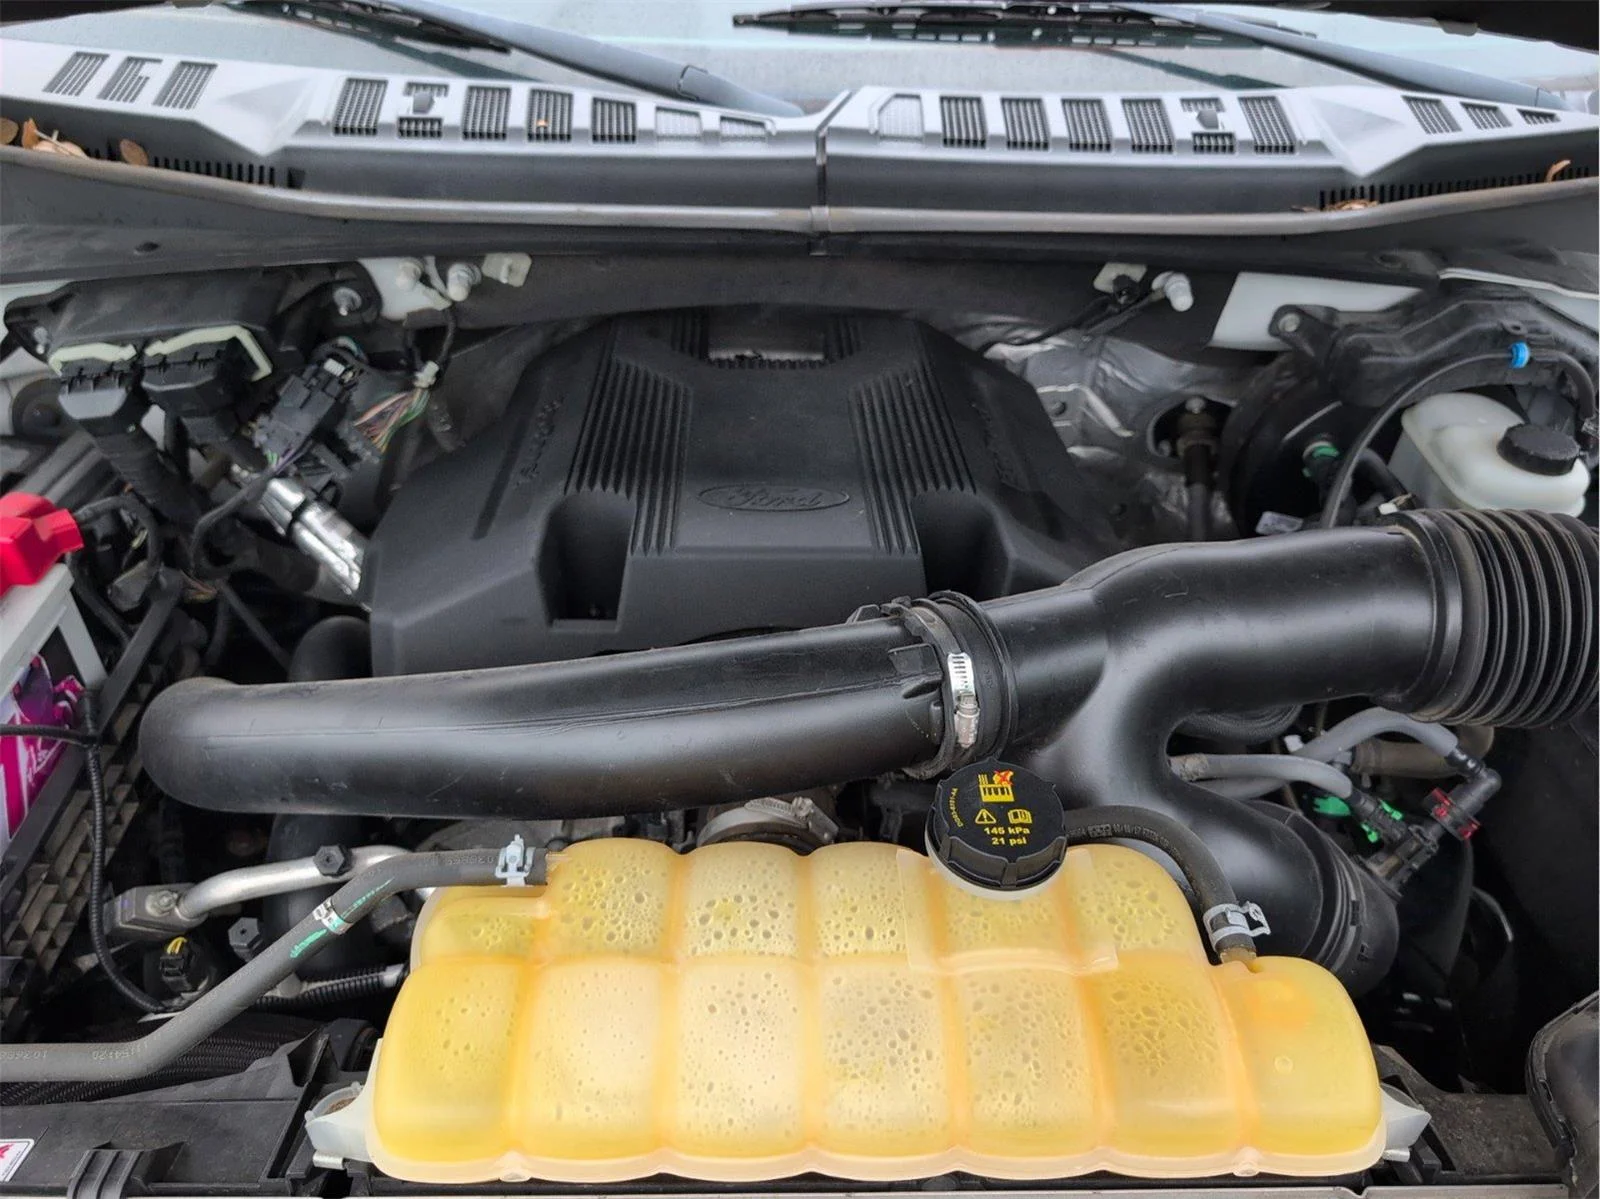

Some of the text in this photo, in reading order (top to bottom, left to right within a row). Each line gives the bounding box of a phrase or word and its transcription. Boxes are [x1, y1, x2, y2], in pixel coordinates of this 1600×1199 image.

[727, 487, 823, 508] Ford
[984, 827, 1031, 835] 145 kPa
[992, 837, 1028, 846] 21 psi
